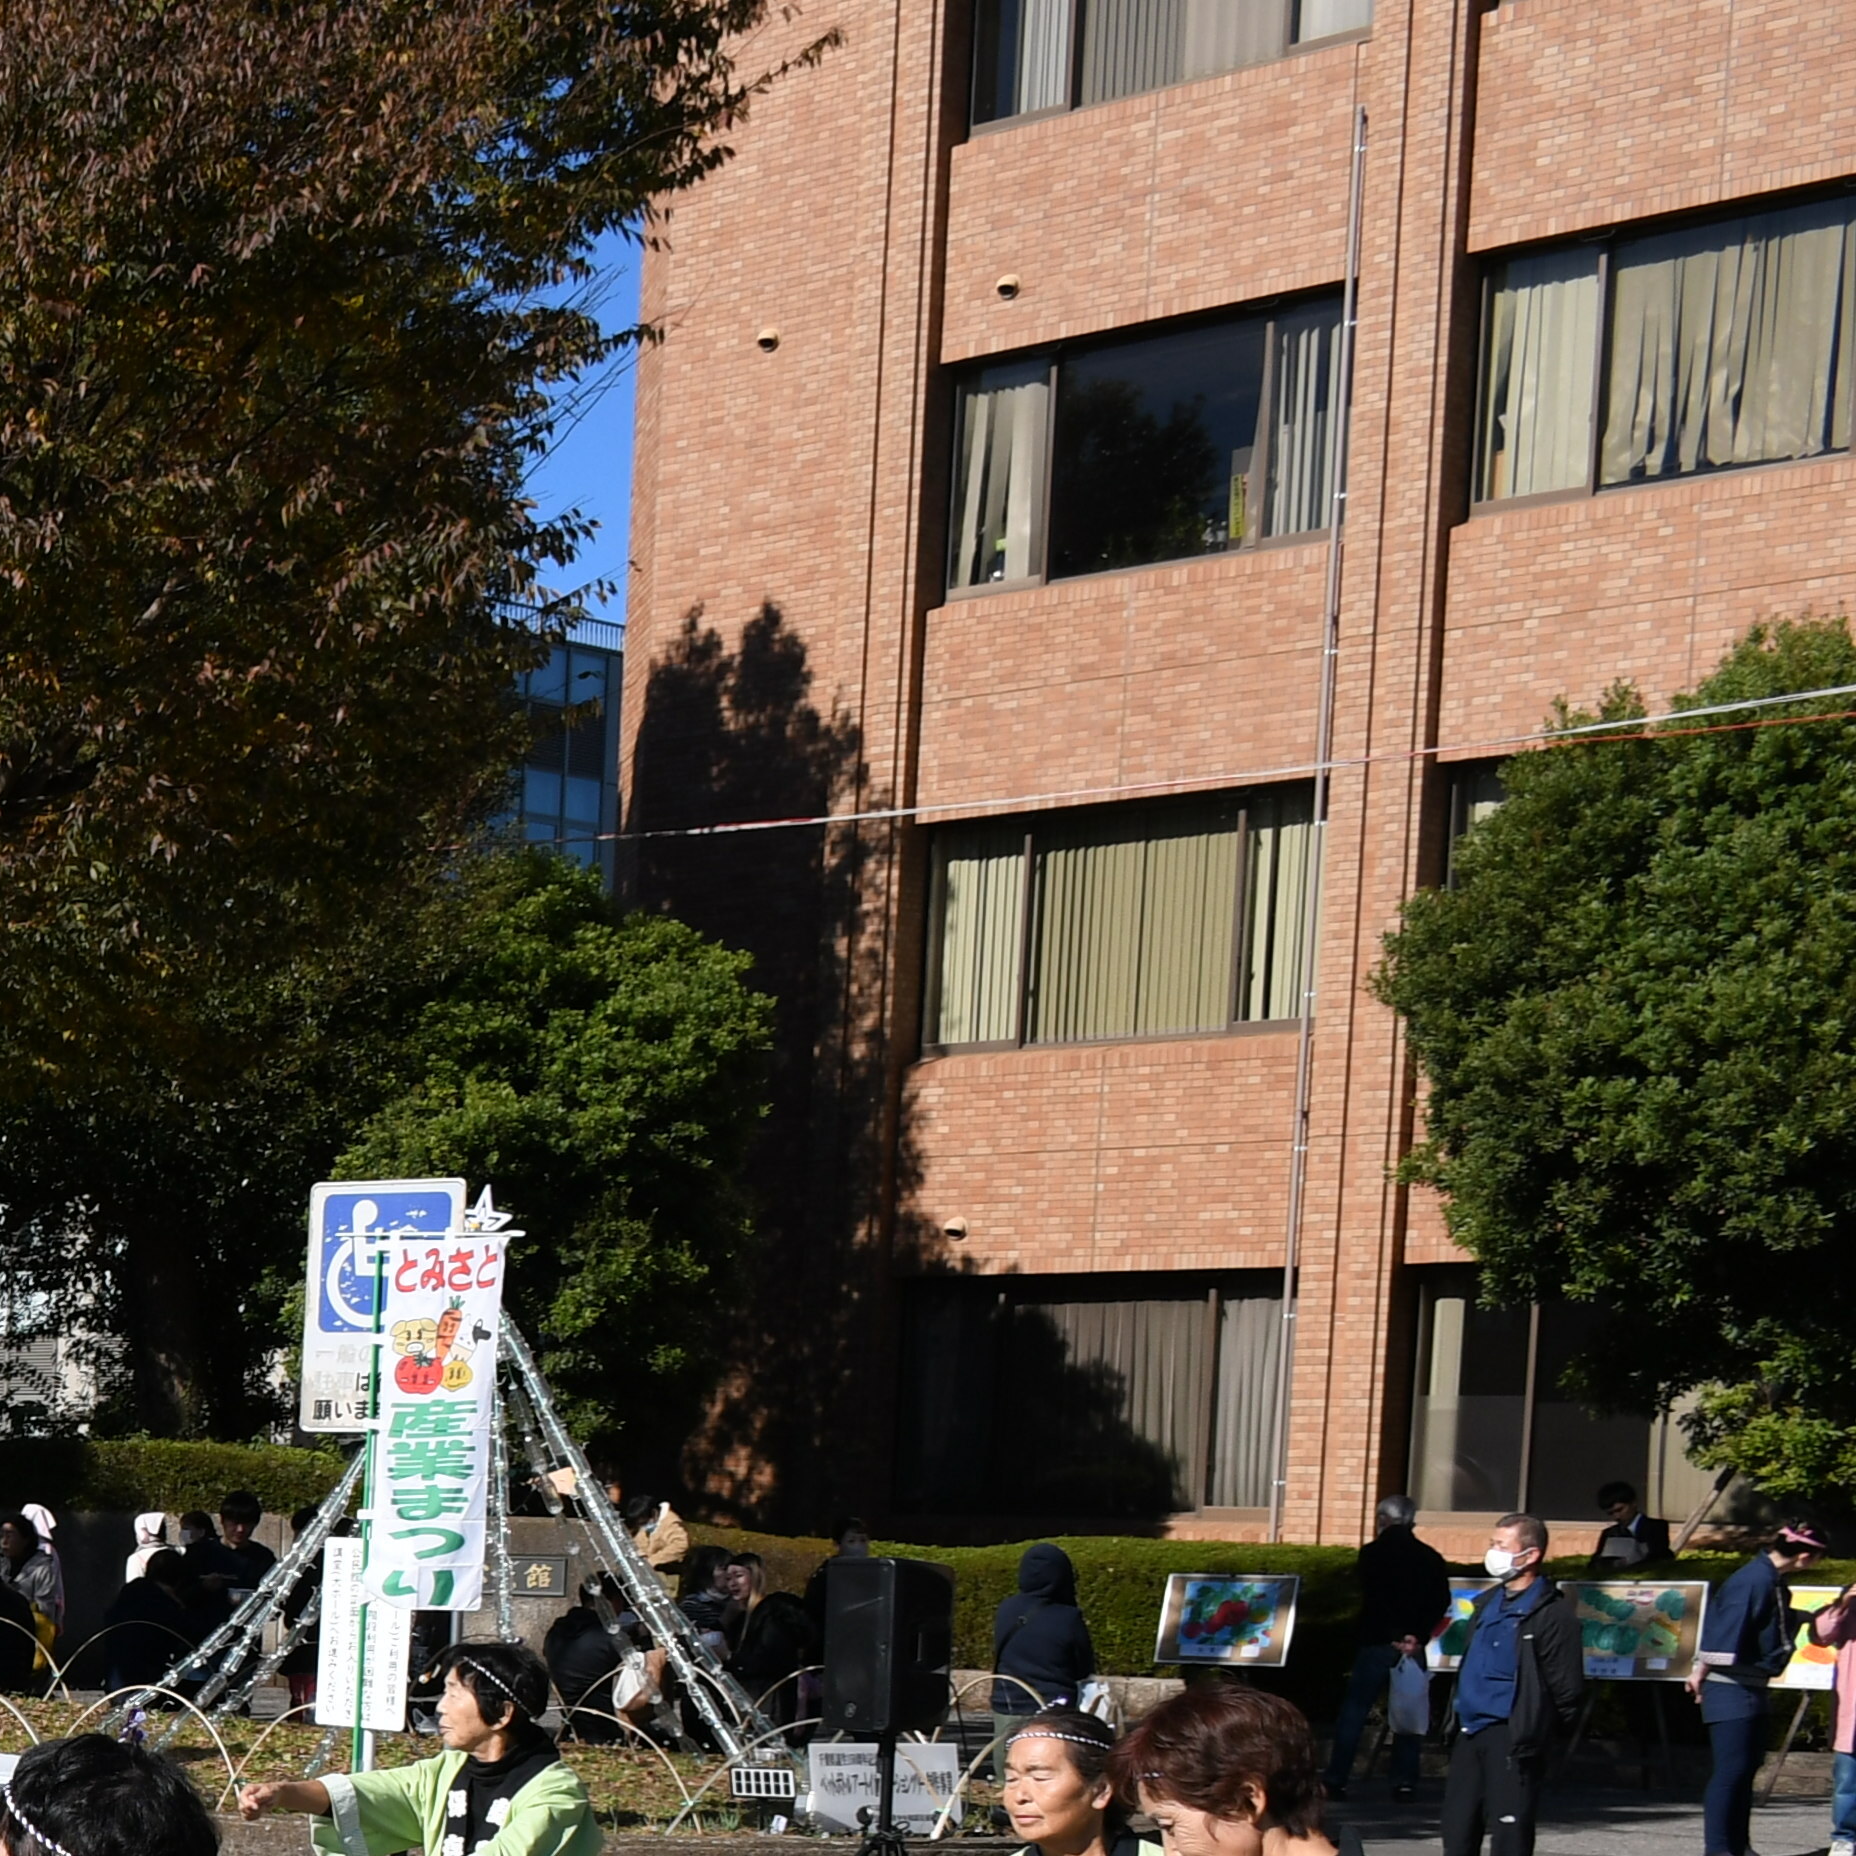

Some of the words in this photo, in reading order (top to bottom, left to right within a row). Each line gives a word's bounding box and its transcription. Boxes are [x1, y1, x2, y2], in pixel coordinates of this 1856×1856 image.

[394, 1245, 499, 1293] とみさと
[313, 1399, 380, 1421] 願いま
[382, 1399, 478, 1606] 産業まつり
